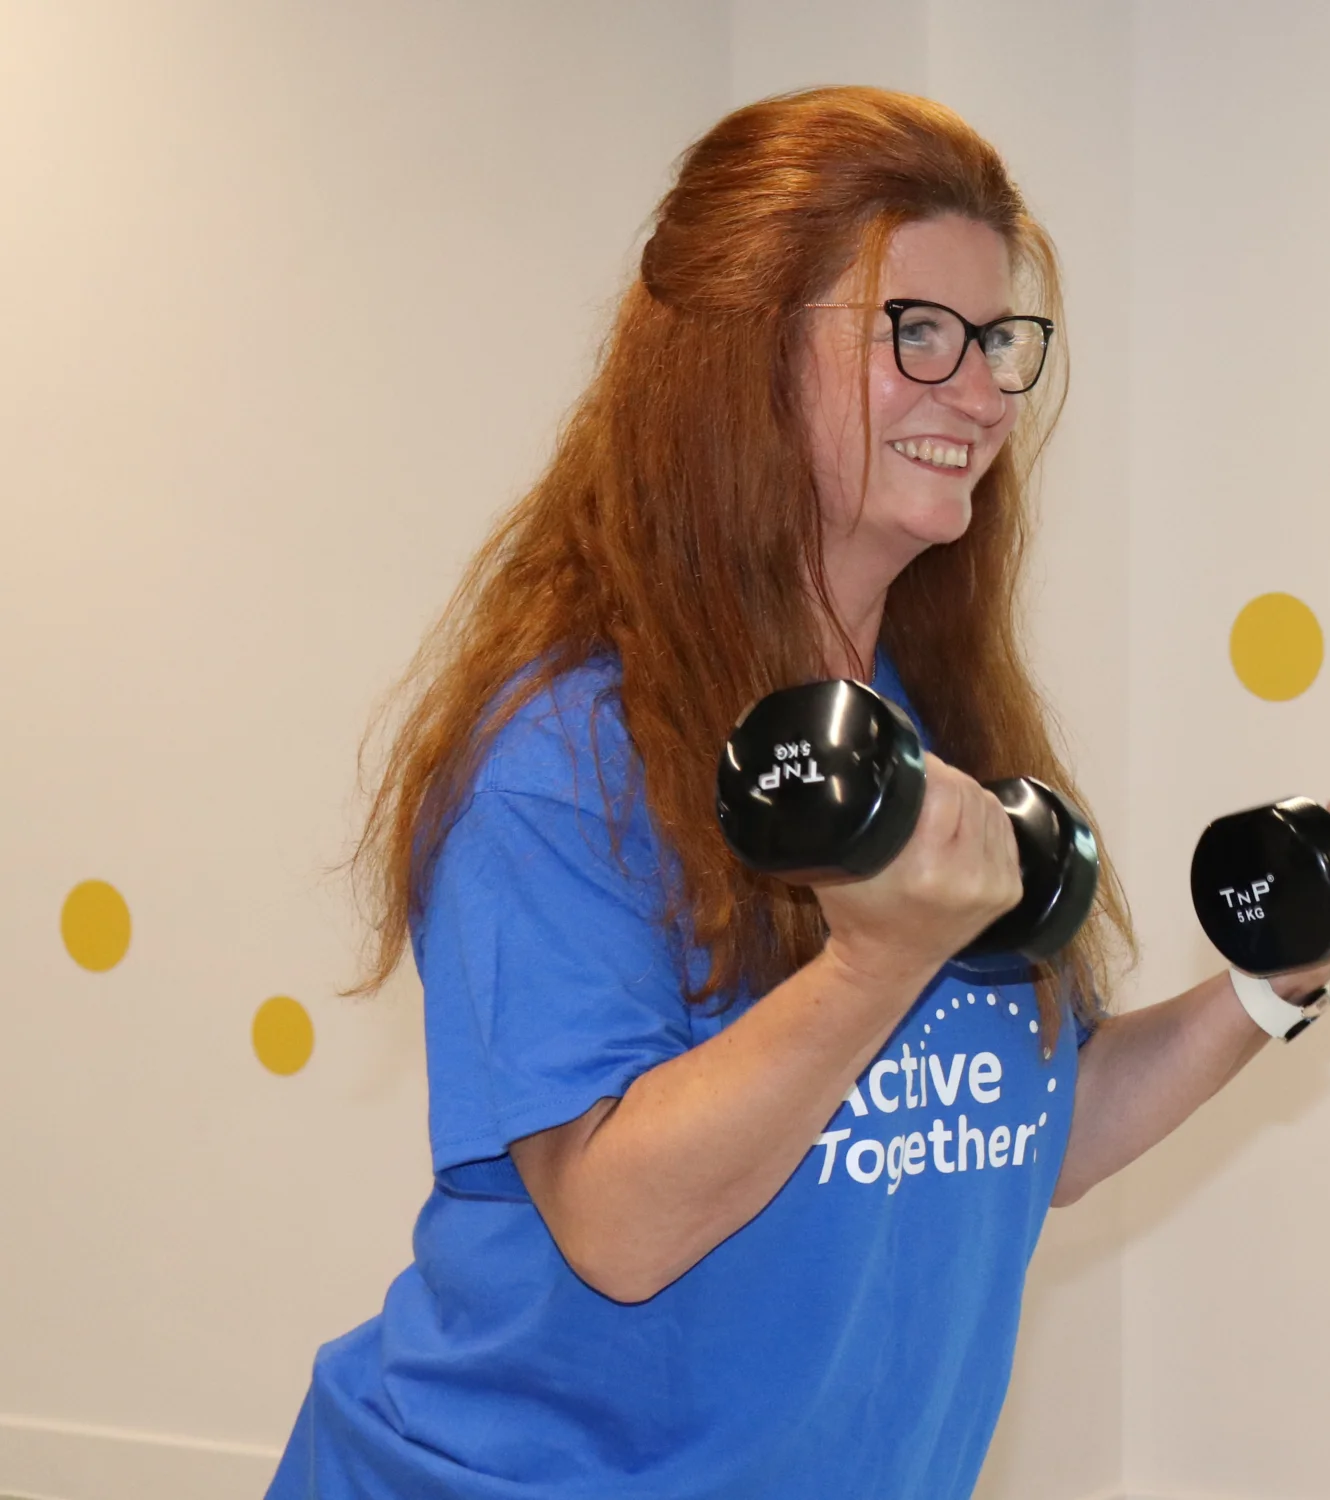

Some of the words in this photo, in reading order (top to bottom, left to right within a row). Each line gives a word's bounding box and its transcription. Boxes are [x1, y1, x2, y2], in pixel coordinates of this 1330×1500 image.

[774, 743, 799, 761] KG
[1245, 907, 1265, 921] KG
[813, 1114, 1037, 1195] Together
